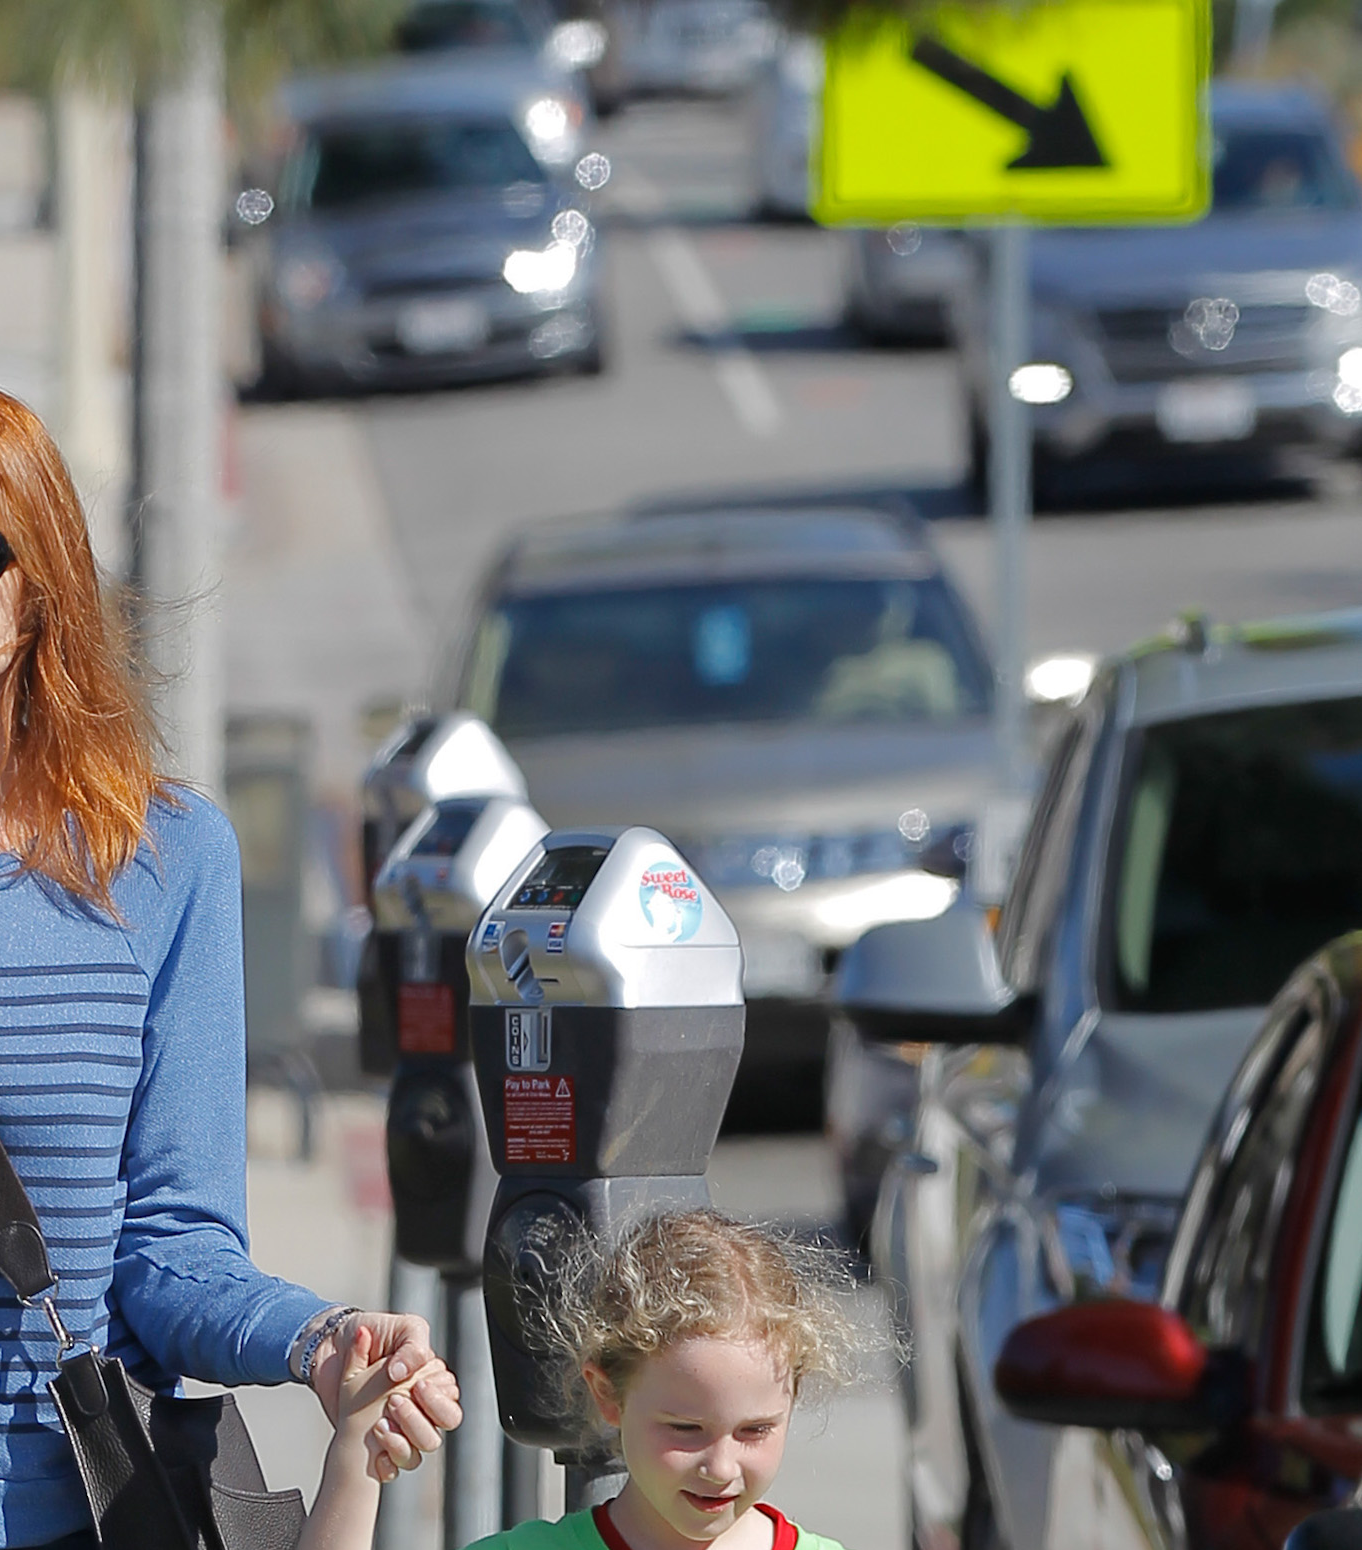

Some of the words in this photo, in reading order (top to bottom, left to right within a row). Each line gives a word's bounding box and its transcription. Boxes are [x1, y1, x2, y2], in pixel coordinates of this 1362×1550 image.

[641, 869, 687, 887] Sweet
[660, 883, 698, 902] Rose
[511, 1016, 520, 1065] COINS
[505, 1079, 520, 1091] Pay
[522, 1079, 531, 1090] to
[532, 1079, 551, 1090] Park
